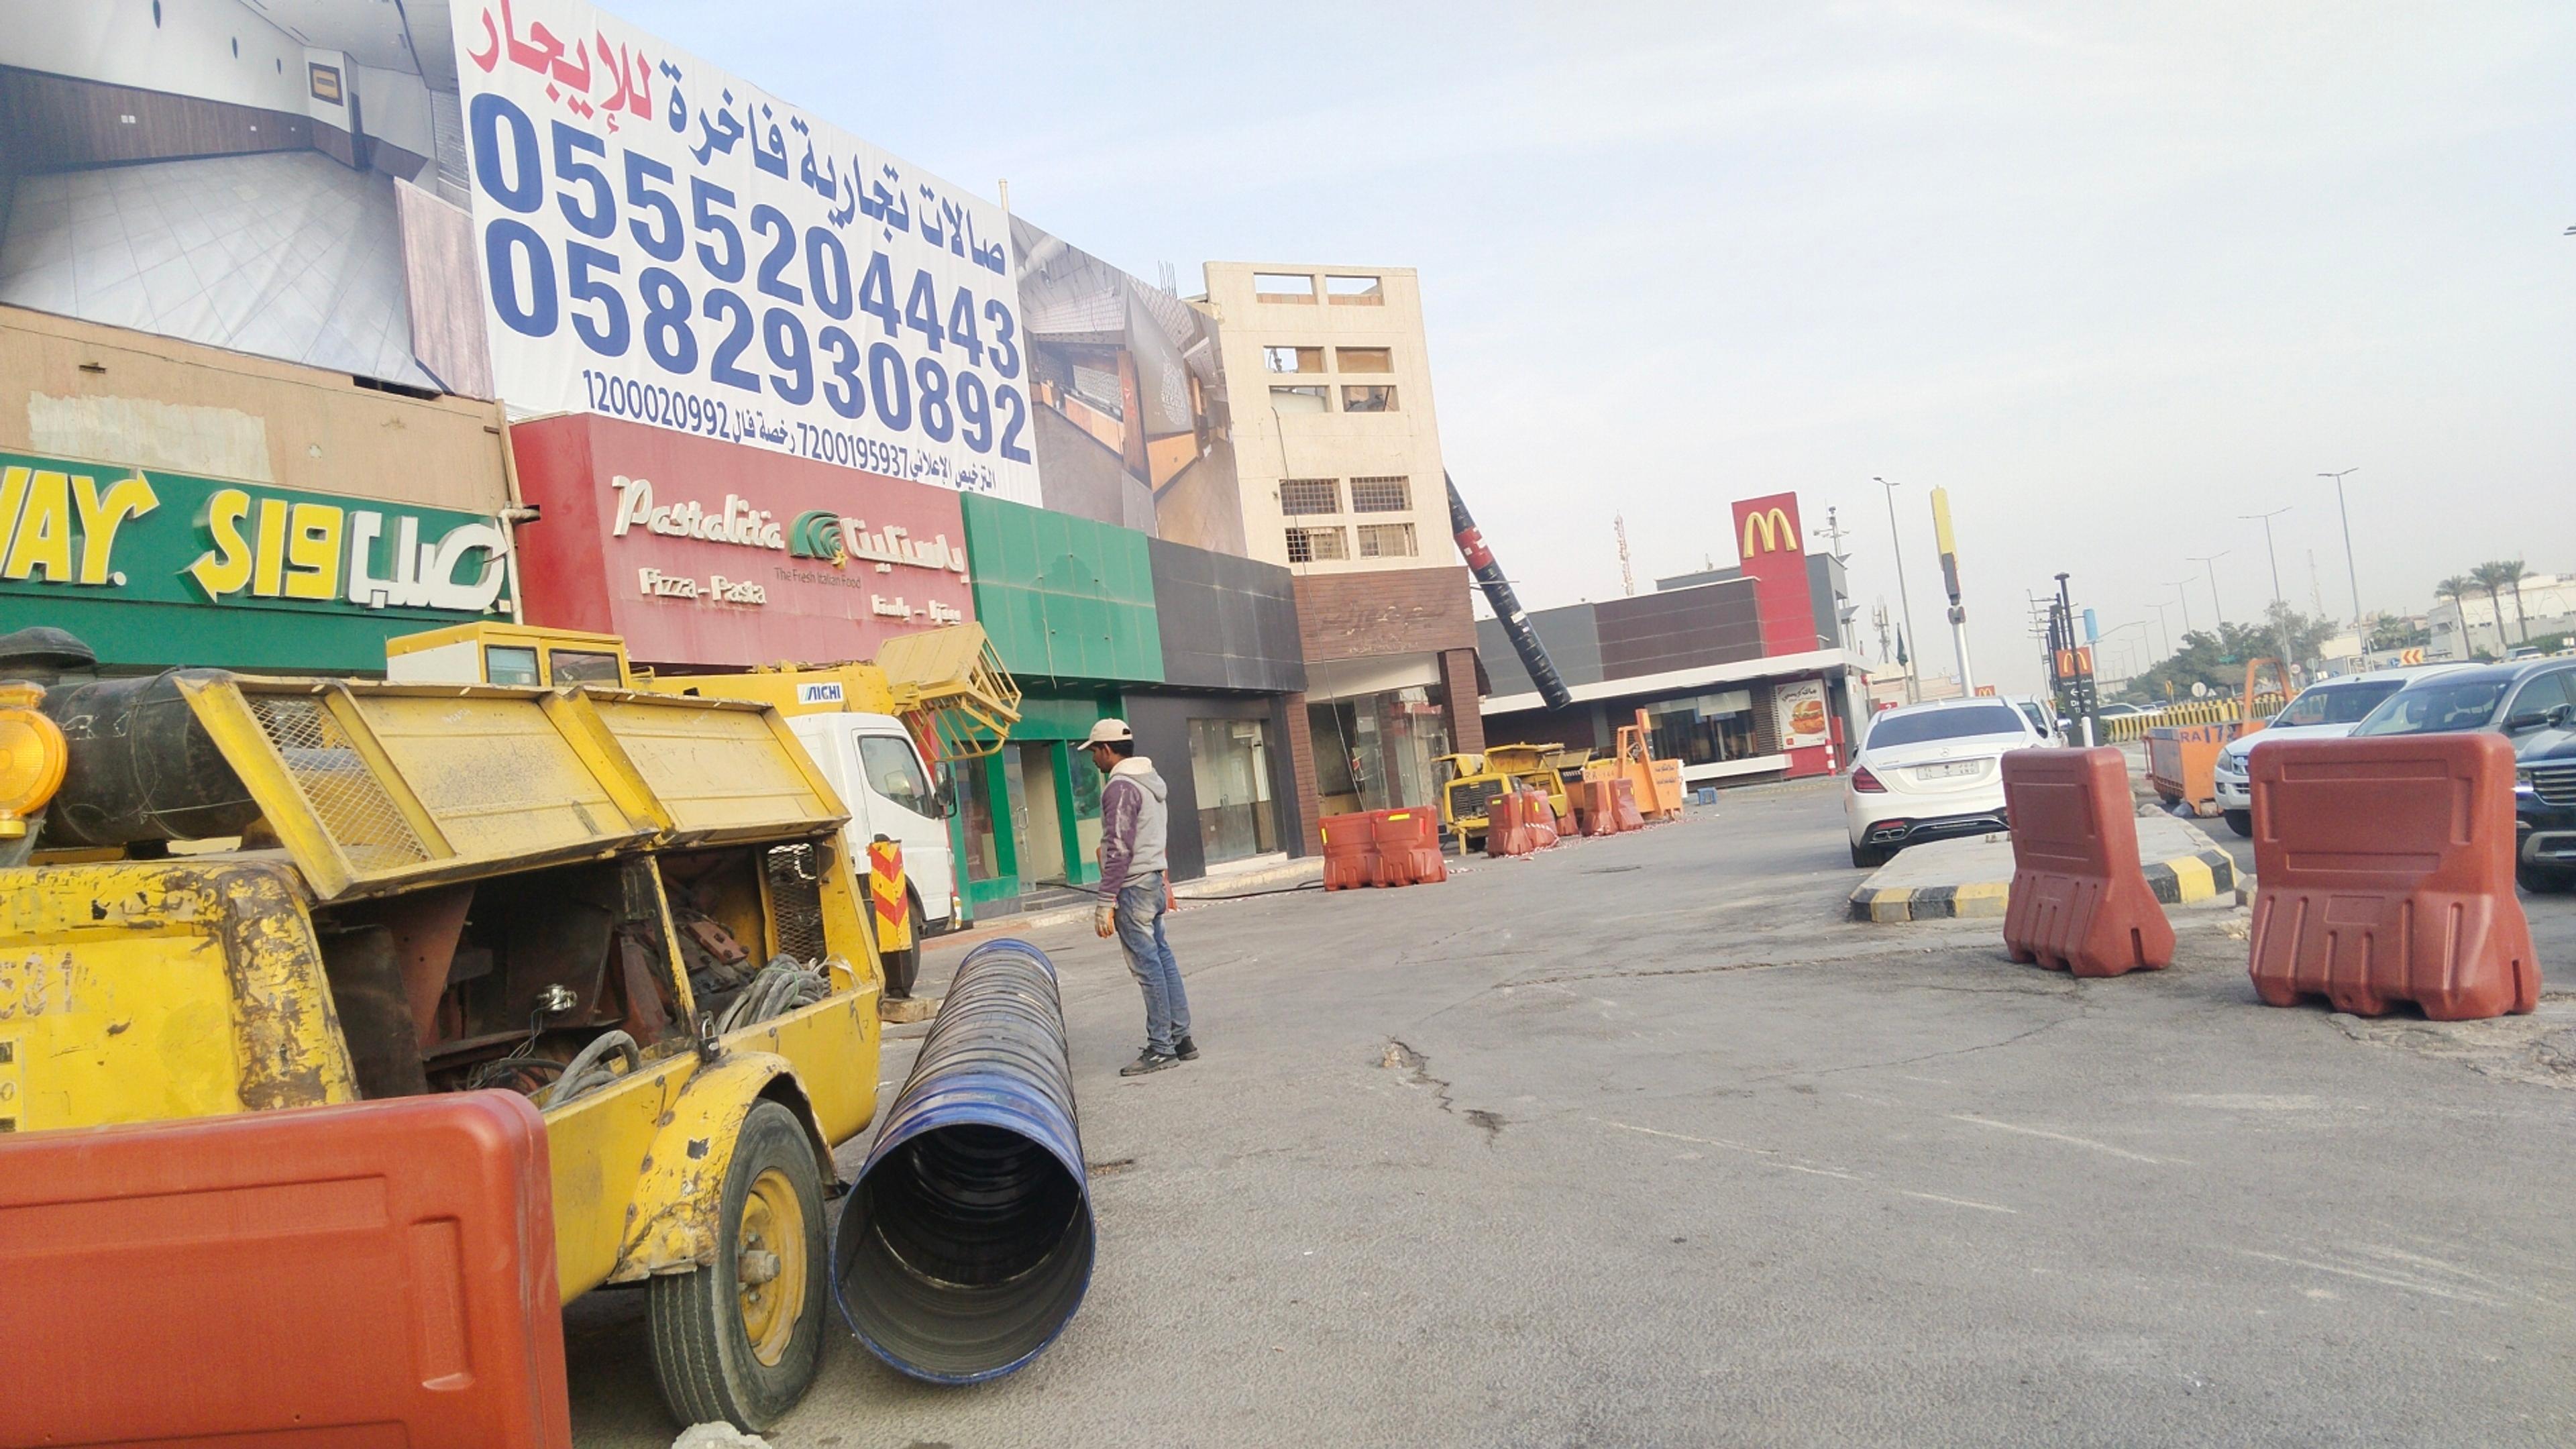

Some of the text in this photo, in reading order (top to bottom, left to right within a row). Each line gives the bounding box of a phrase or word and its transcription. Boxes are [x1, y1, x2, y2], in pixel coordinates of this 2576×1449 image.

[466, 0, 1006, 276] صالات تجارية فاخرة للإيجار
[470, 92, 1020, 380] 0555204443
[485, 217, 1032, 465] 0582930892
[582, 369, 730, 439] 1200020992
[732, 408, 756, 444] فال
[756, 410, 796, 454] رخصة
[796, 421, 908, 478] 7200195937
[773, 567, 861, 589] The Fresh Italian Food
[806, 685, 841, 701] AICHI
